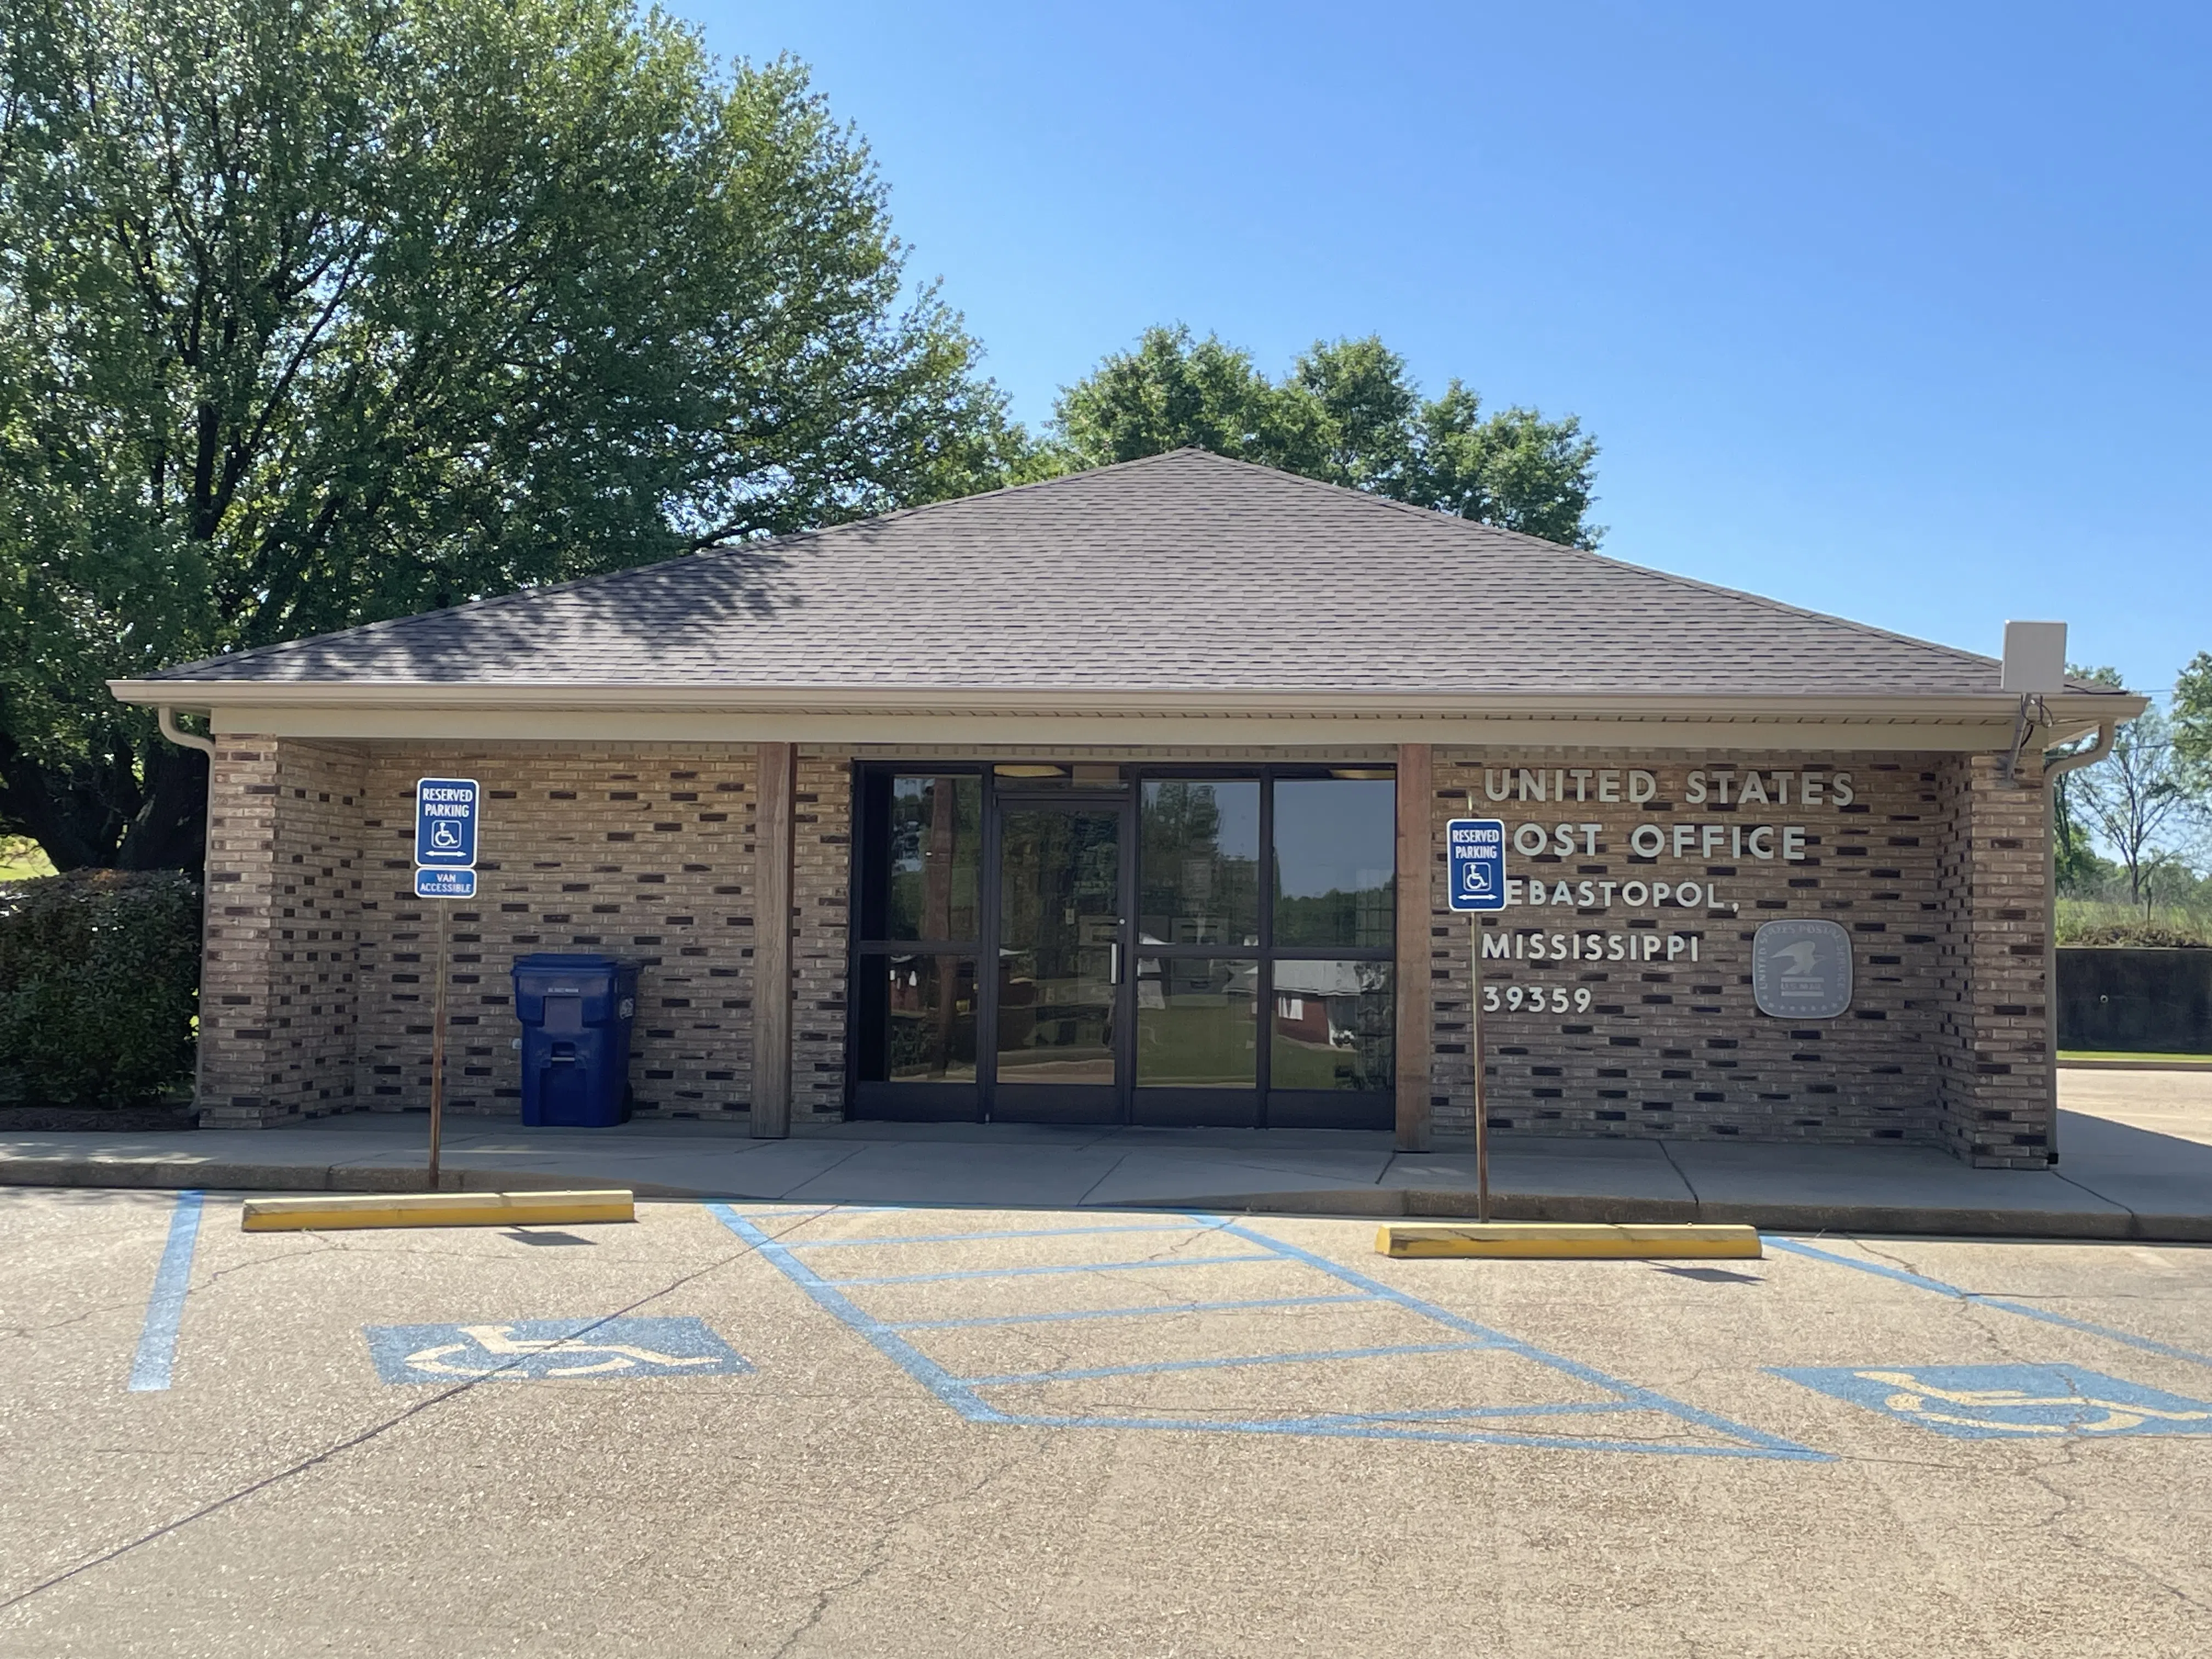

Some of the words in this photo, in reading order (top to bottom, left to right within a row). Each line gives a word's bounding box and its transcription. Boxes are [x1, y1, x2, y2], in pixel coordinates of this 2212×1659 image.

[1484, 769, 1657, 803] UNITED
[1686, 770, 1854, 806] STATES
[423, 788, 473, 802] RESERVED
[425, 804, 470, 817] PARKING
[1452, 829, 1500, 843] RESERVED
[1513, 823, 1602, 857] OST
[1630, 824, 1808, 861] OFFICE
[1455, 846, 1497, 859] PARKING
[436, 873, 456, 882] VAN
[420, 883, 472, 893] ACCESSIBLE
[1506, 879, 1740, 913] EBASTOPOL,
[1481, 933, 1700, 962] MISSISSIPPI
[1483, 987, 1592, 1014] 39359
